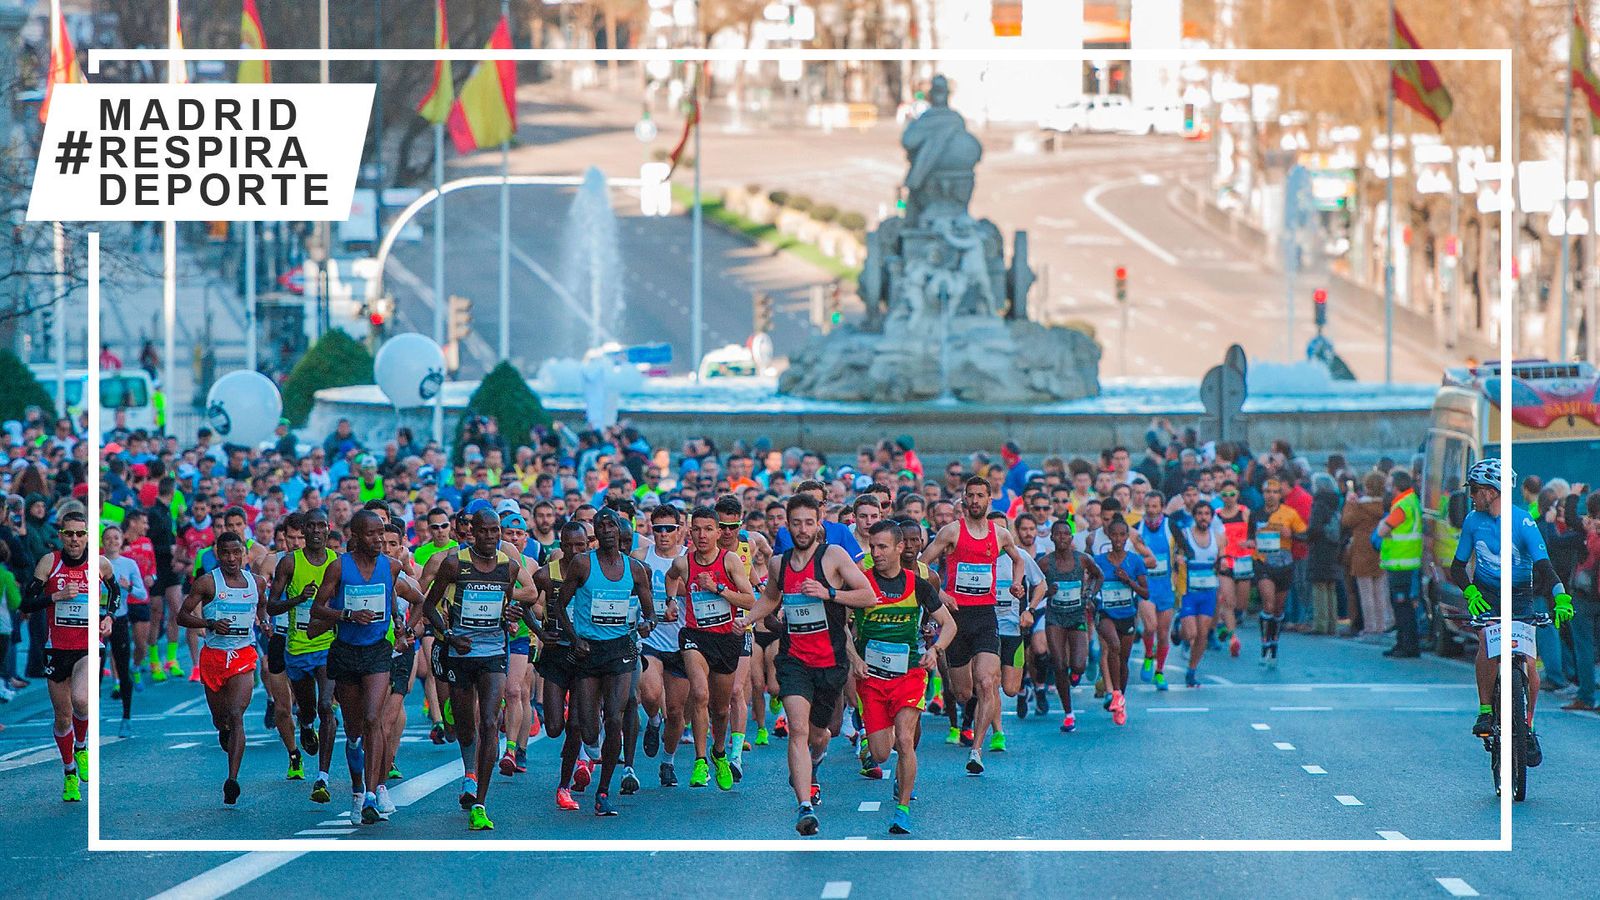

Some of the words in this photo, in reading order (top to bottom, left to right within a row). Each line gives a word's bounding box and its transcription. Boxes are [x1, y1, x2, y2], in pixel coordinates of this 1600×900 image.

[363, 599, 369, 607] 7
[706, 603, 716, 611] 11
[68, 605, 82, 613] 127
[478, 604, 489, 613] 40
[795, 608, 810, 617] 186
[881, 655, 891, 664] 59
